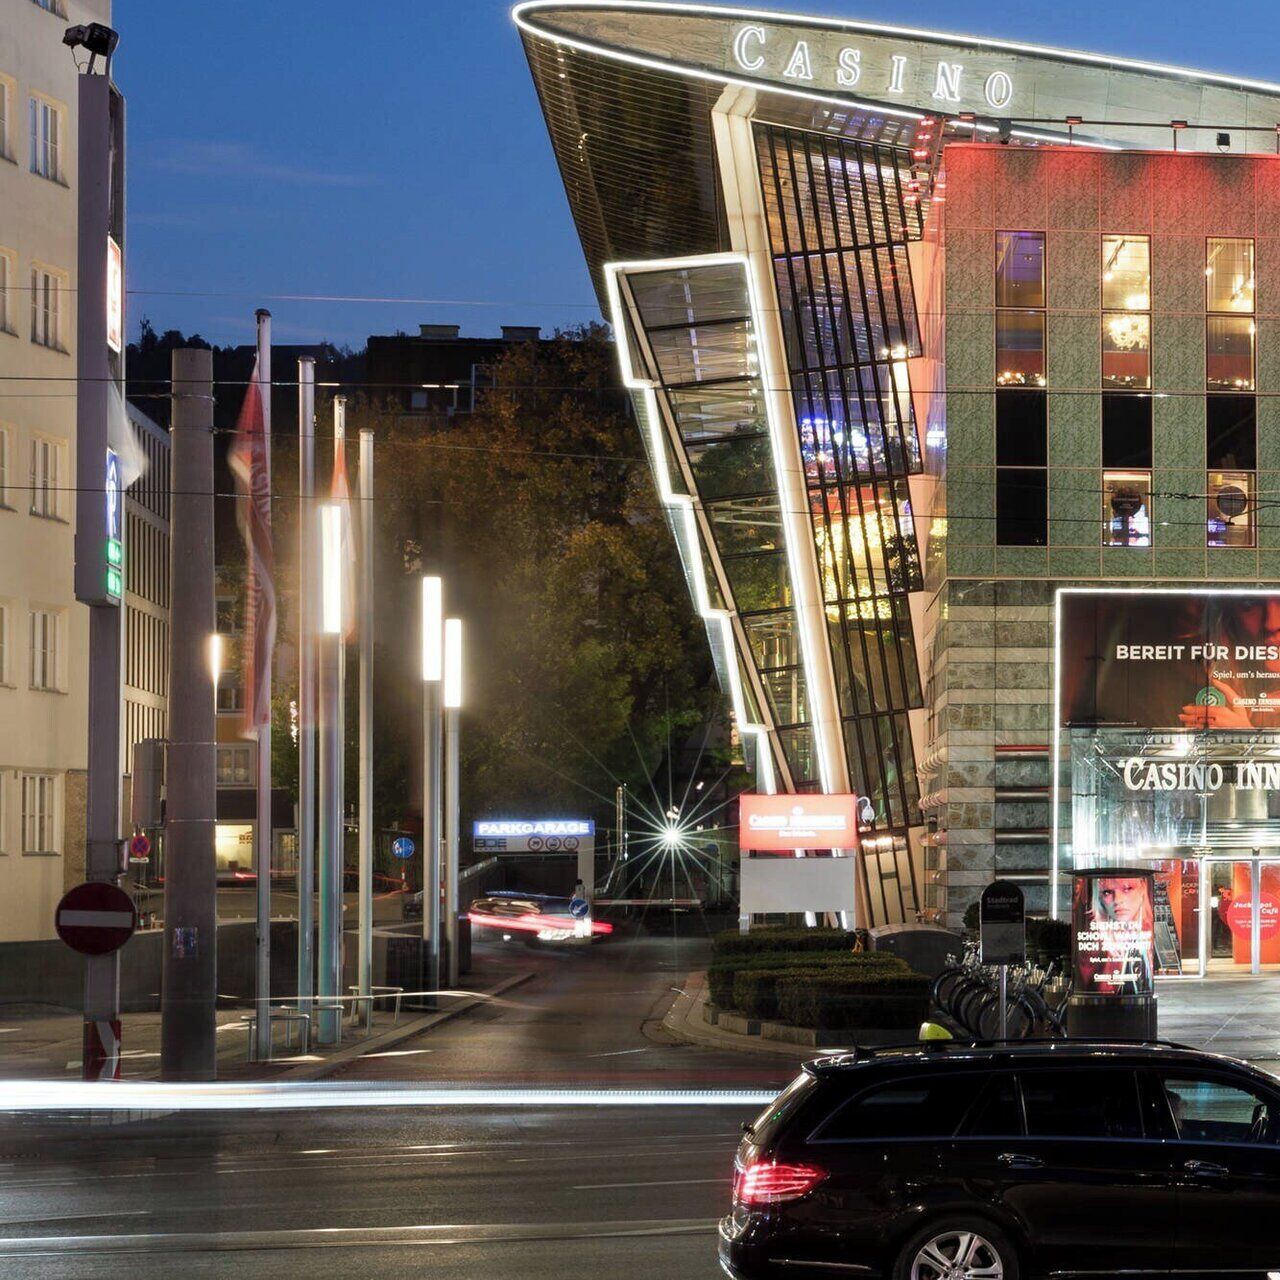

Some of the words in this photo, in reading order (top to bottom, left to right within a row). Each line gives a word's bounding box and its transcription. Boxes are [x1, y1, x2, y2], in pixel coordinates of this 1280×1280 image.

[733, 25, 1014, 109] CASINO
[1116, 645, 1185, 660] BEREIT
[1191, 642, 1228, 660] FÜR
[1213, 670, 1234, 681] Spiel,
[1123, 754, 1223, 792] CASINO
[478, 822, 590, 834] PARKGARAGE
[1078, 941, 1099, 951] DICH
